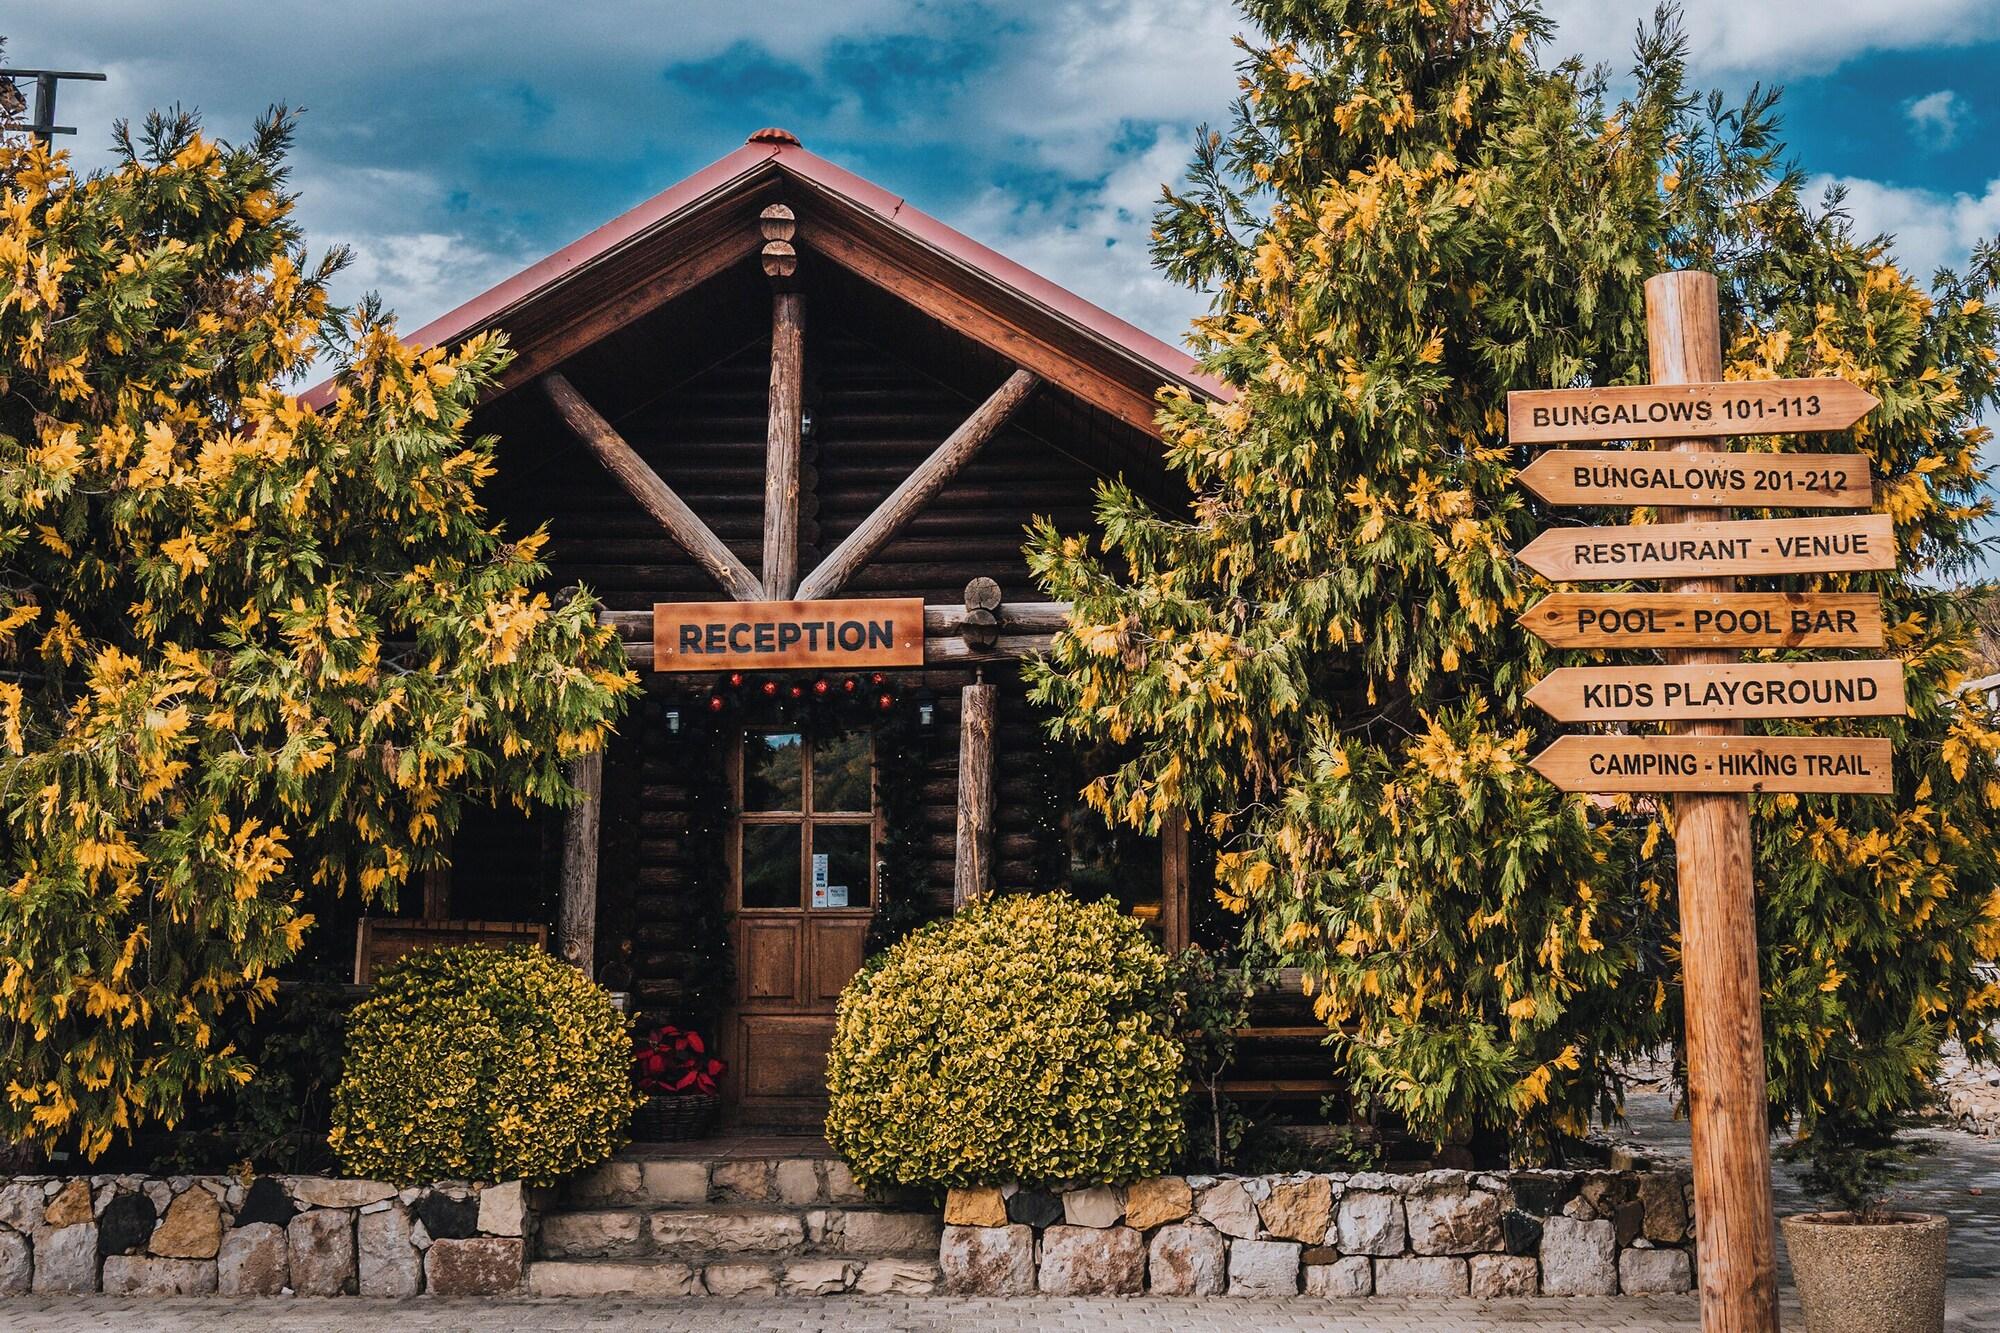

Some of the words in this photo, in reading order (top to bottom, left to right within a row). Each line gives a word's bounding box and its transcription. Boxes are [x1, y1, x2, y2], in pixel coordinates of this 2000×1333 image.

[1533, 400, 1712, 427] BUNGALOWS
[1722, 395, 1822, 419] 101-113
[1573, 466, 1745, 490] BUNGALOWS
[1753, 470, 1848, 492] 201-212
[1574, 538, 1752, 565] RESTAURANT
[1775, 534, 1869, 558] VENUE
[1577, 609, 1666, 633] POOL
[1694, 609, 1782, 634] POOL
[1791, 609, 1859, 633] BAR
[679, 620, 894, 655] RECEPTION
[1583, 683, 1655, 709] KIDS
[1664, 677, 1878, 707] PLAYGROUND
[1590, 753, 1698, 776] CAMPING
[1718, 753, 1797, 776] HIKING
[1803, 754, 1871, 776] TRAIL
